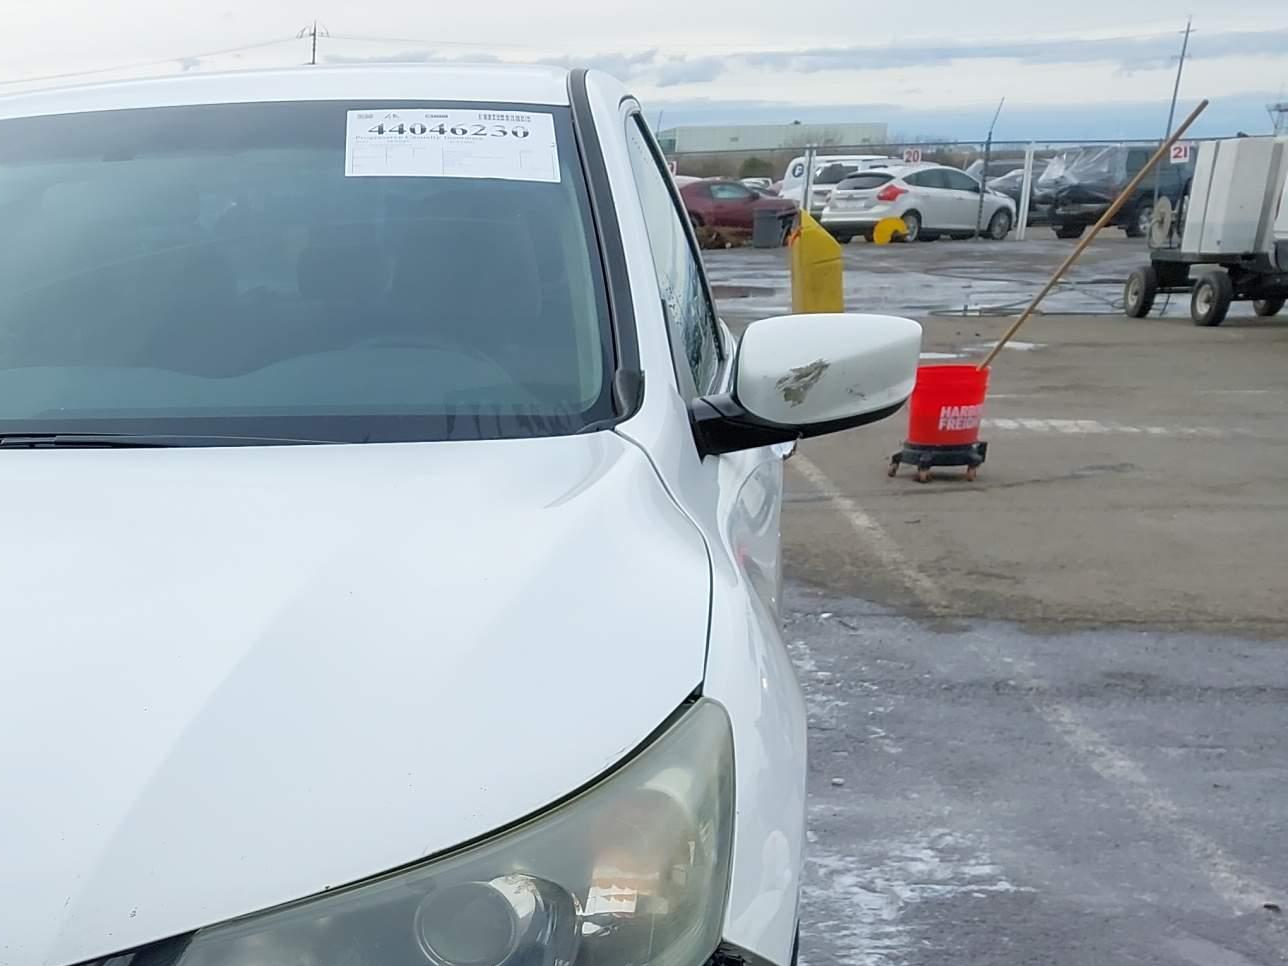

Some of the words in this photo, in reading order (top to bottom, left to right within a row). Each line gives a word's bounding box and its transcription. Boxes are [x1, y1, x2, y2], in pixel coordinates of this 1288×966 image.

[368, 123, 529, 138] 44046230
[905, 151, 919, 161] 20
[1172, 147, 1187, 158] 21
